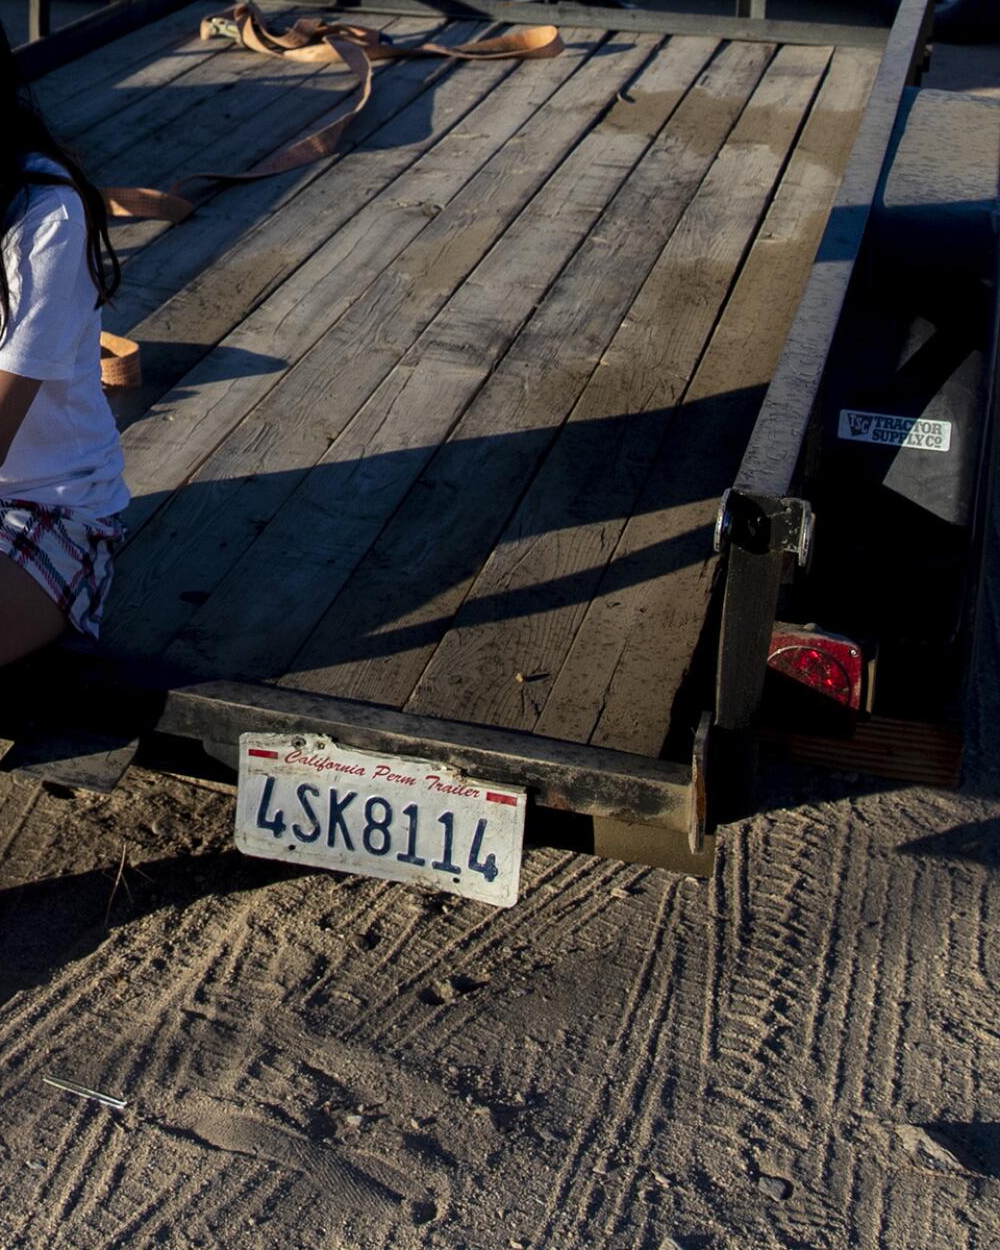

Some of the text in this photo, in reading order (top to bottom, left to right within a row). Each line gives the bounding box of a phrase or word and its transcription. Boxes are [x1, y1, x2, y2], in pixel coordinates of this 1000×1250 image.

[871, 429, 925, 446] SUPPLY
[873, 416, 942, 434] TRACTOR
[284, 750, 481, 799] California Perm Trailer
[256, 773, 499, 884] 4SK8114
